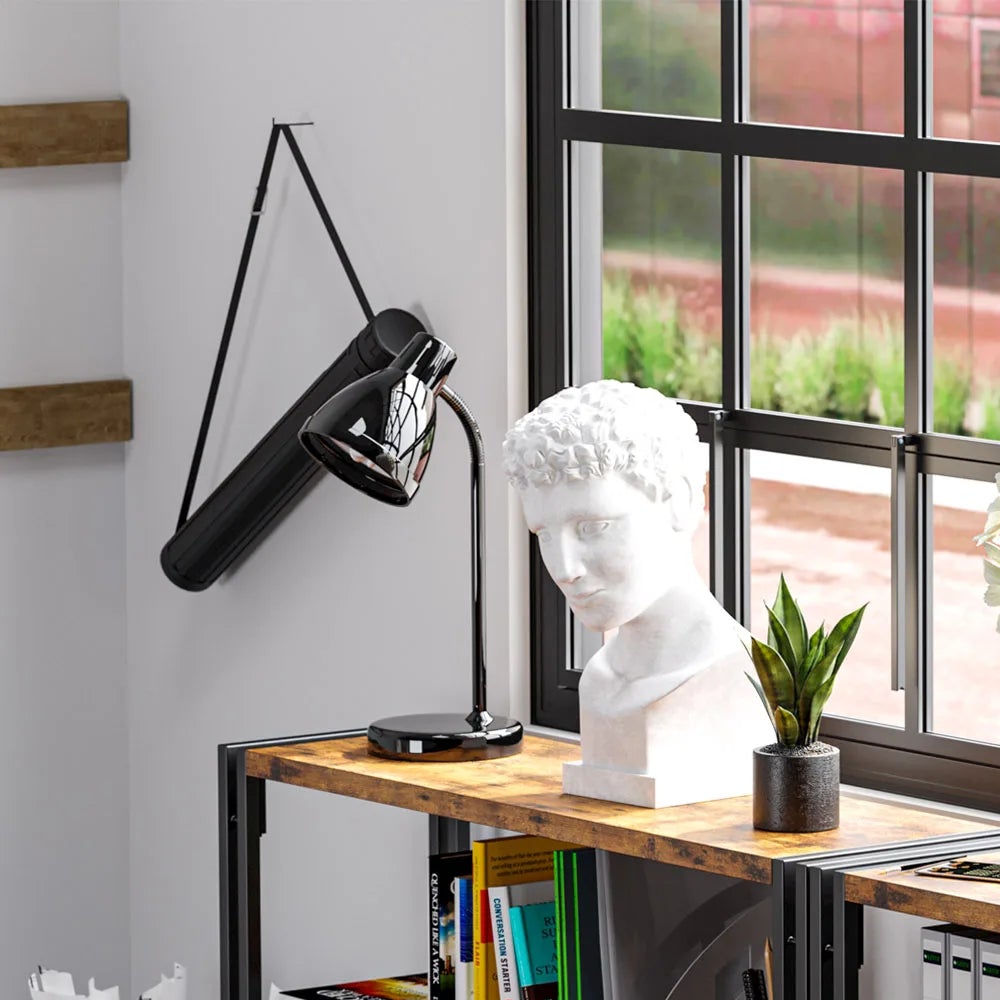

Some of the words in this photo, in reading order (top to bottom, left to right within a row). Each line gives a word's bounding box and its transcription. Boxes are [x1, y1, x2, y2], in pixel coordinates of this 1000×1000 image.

[431, 927, 439, 946] LIKE
[493, 898, 507, 957] CONVERSATION
[500, 958, 511, 993] STARTER
[431, 948, 439, 956] A
[431, 958, 440, 984] WICK
